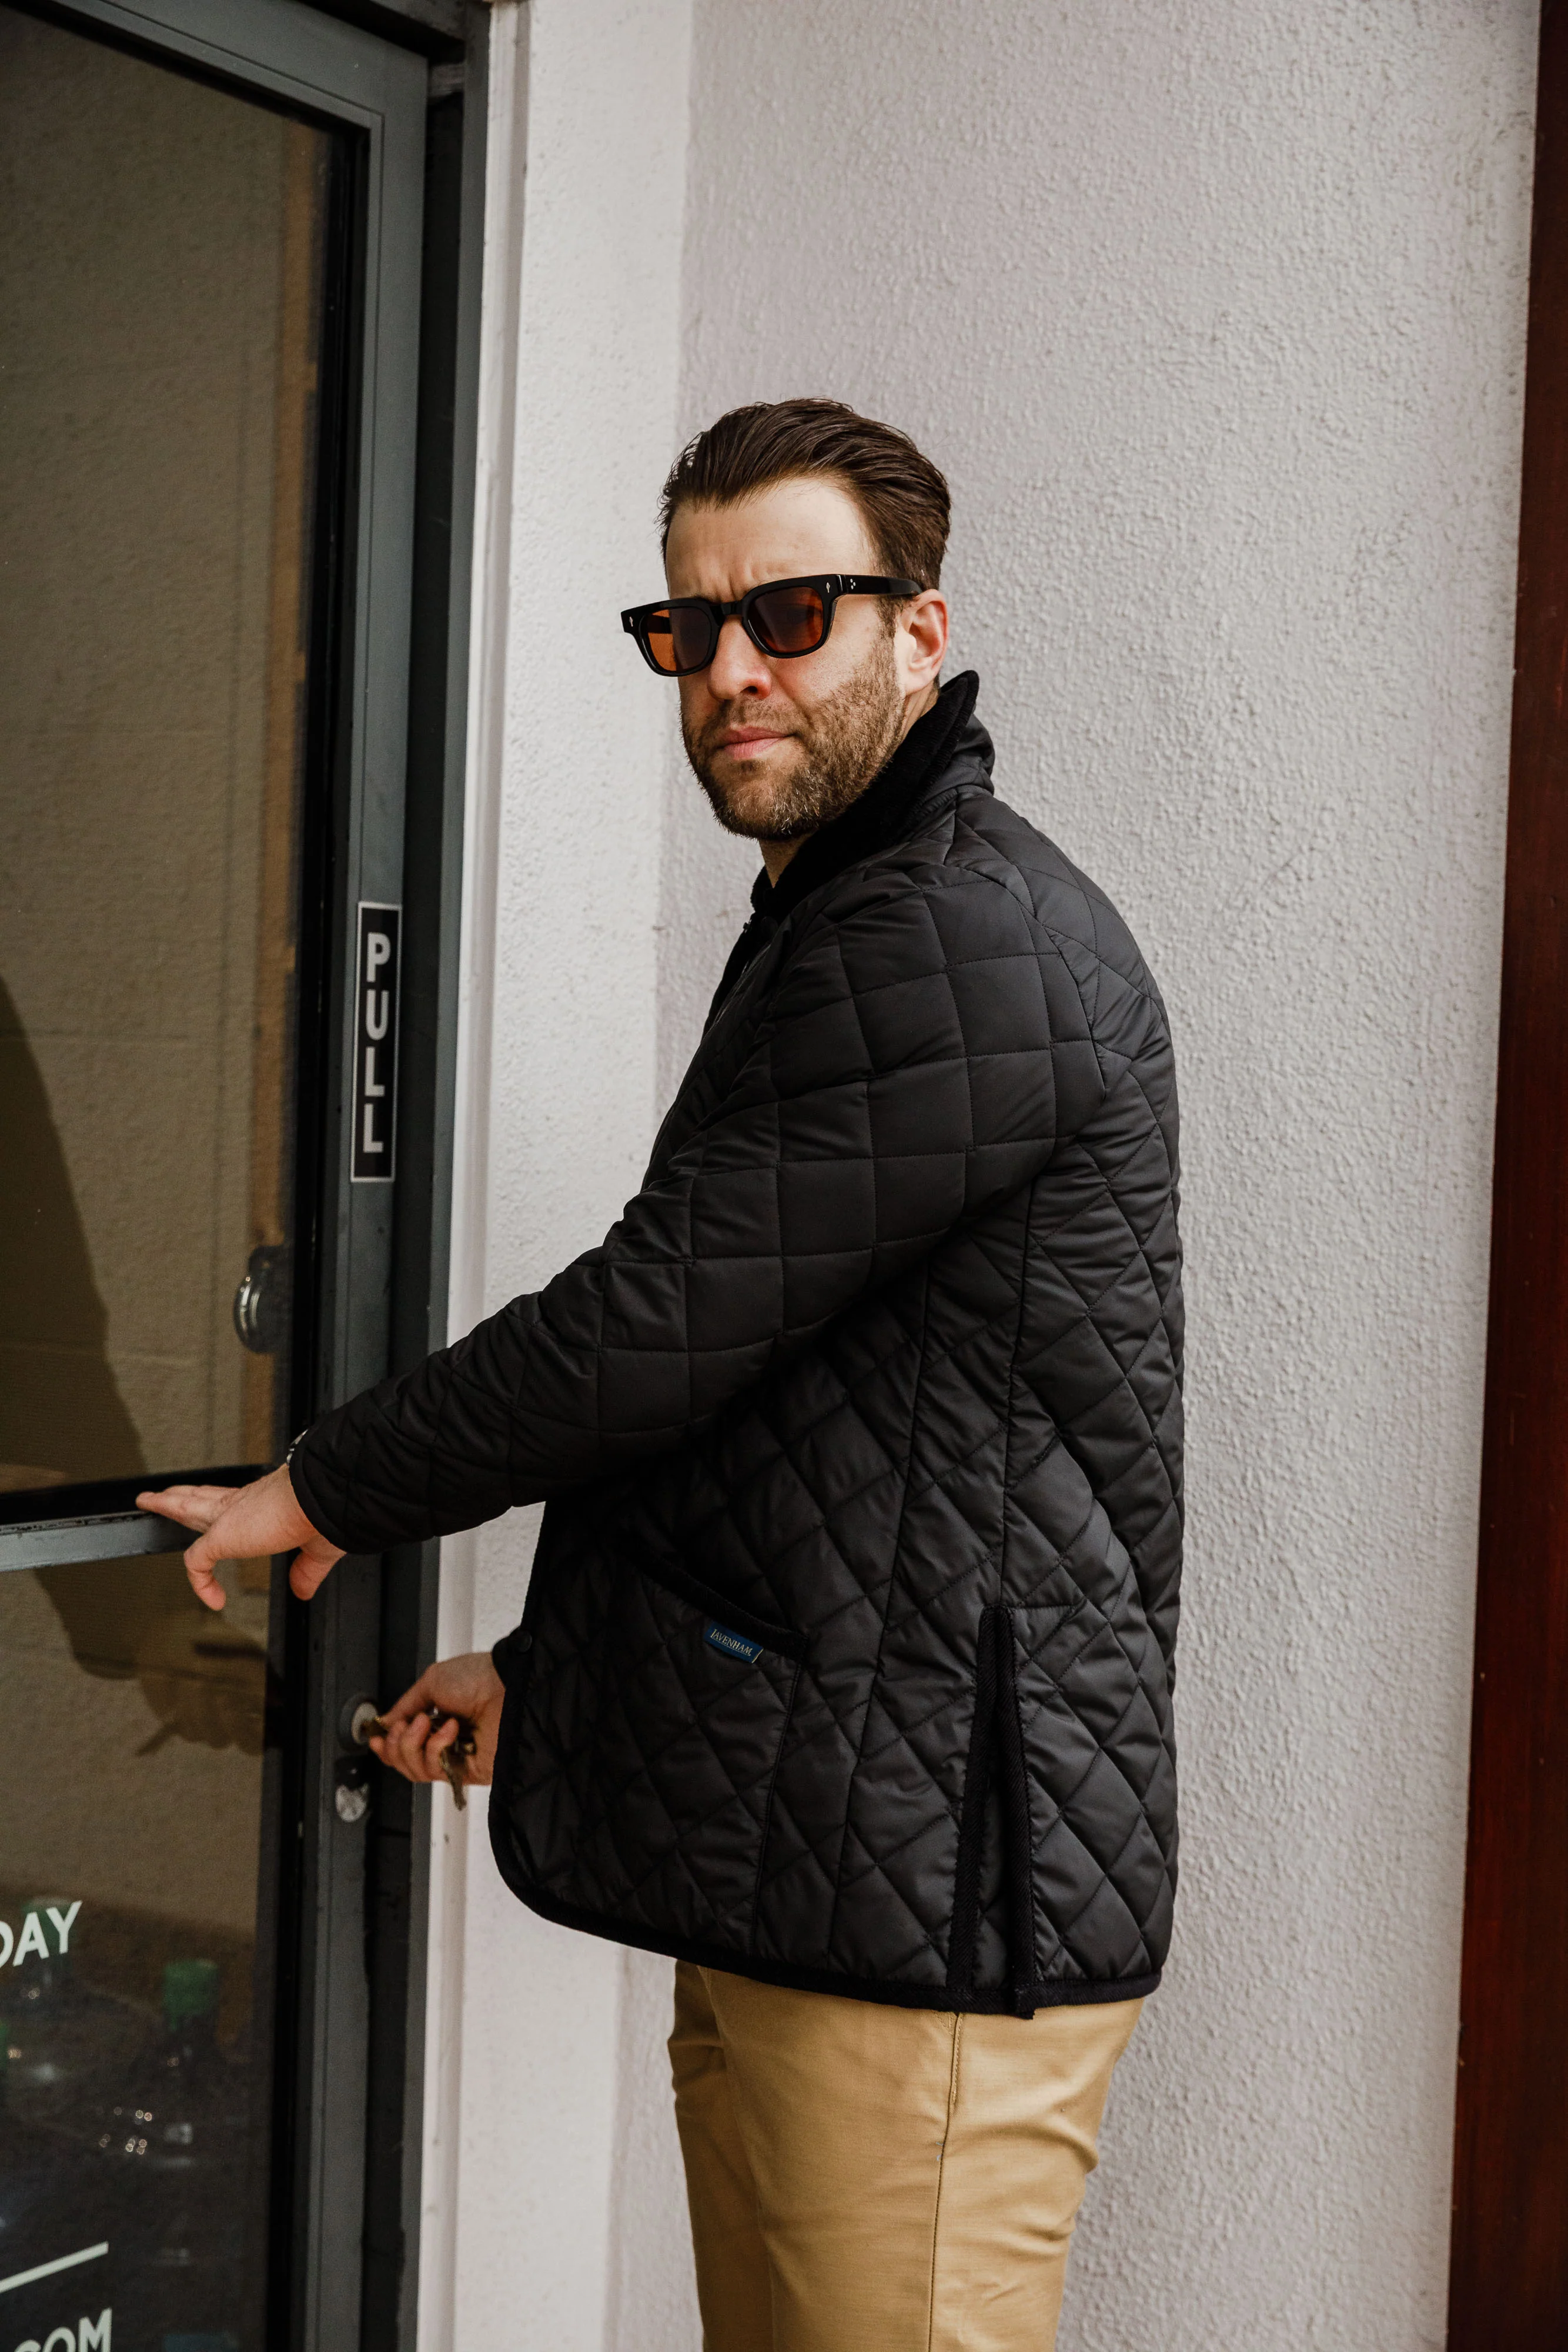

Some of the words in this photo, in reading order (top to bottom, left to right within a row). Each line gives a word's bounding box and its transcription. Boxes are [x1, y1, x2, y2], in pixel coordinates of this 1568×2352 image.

[363, 932, 390, 1153] PULL
[710, 1628, 753, 1656] LAVENHAM
[15, 2307, 112, 2352] OM
